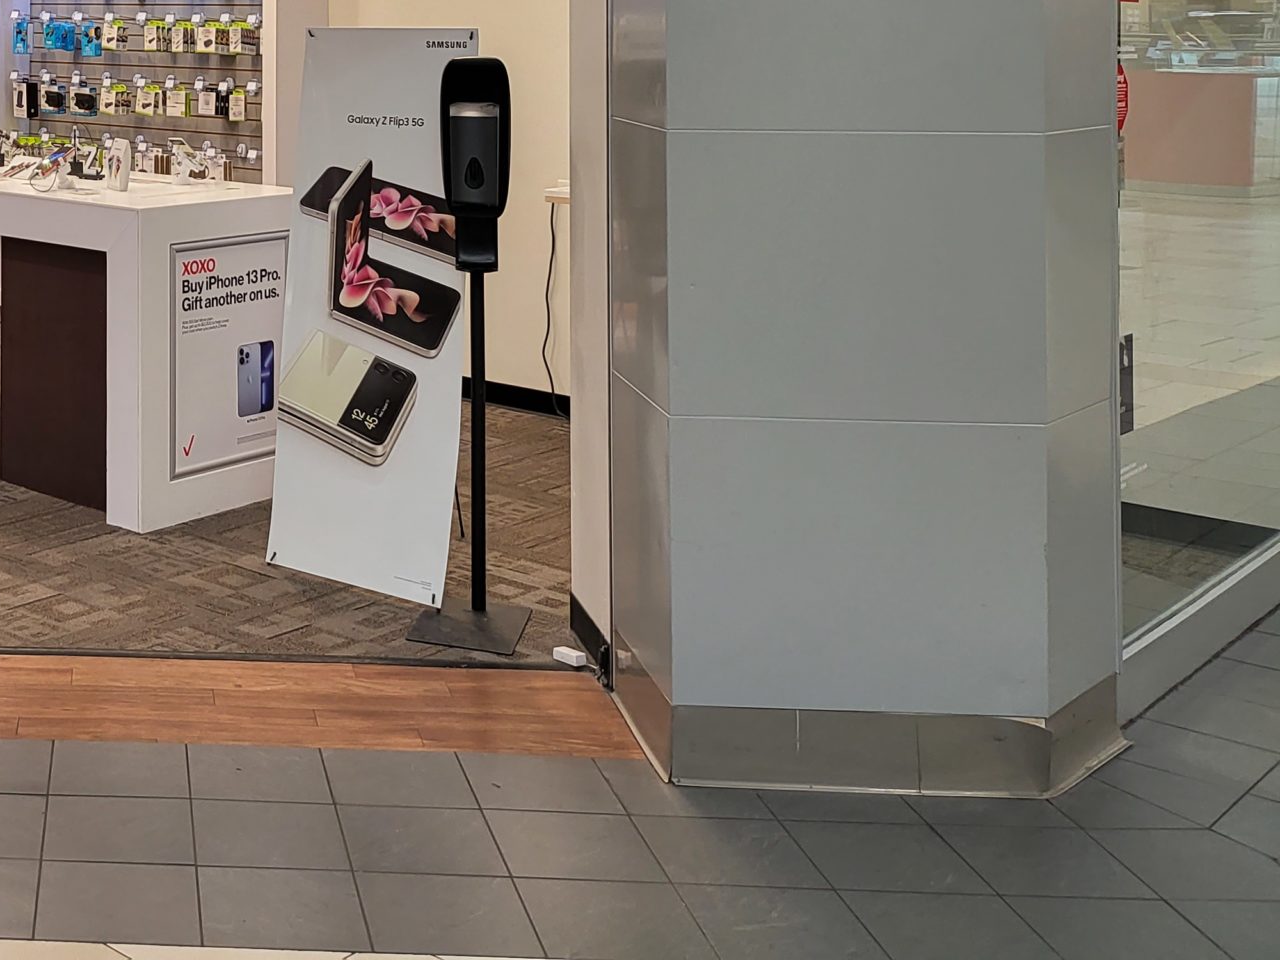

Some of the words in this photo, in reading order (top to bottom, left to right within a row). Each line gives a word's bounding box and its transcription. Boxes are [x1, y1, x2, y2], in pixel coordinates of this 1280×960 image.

[426, 40, 468, 49] SAMSUNG
[347, 114, 380, 127] Galaxy
[381, 116, 387, 125] Z
[388, 116, 410, 128] Flip3
[411, 117, 425, 127] 5G
[182, 258, 216, 276] XOXO
[181, 279, 204, 295] Buy
[205, 274, 244, 291] iPhone
[245, 269, 258, 284] 13
[259, 268, 281, 283] Pro.
[181, 296, 203, 312] Gift
[204, 292, 248, 309] another
[249, 289, 263, 302] on
[264, 286, 280, 299] us.
[351, 408, 366, 421] 12
[364, 415, 379, 430] 45
